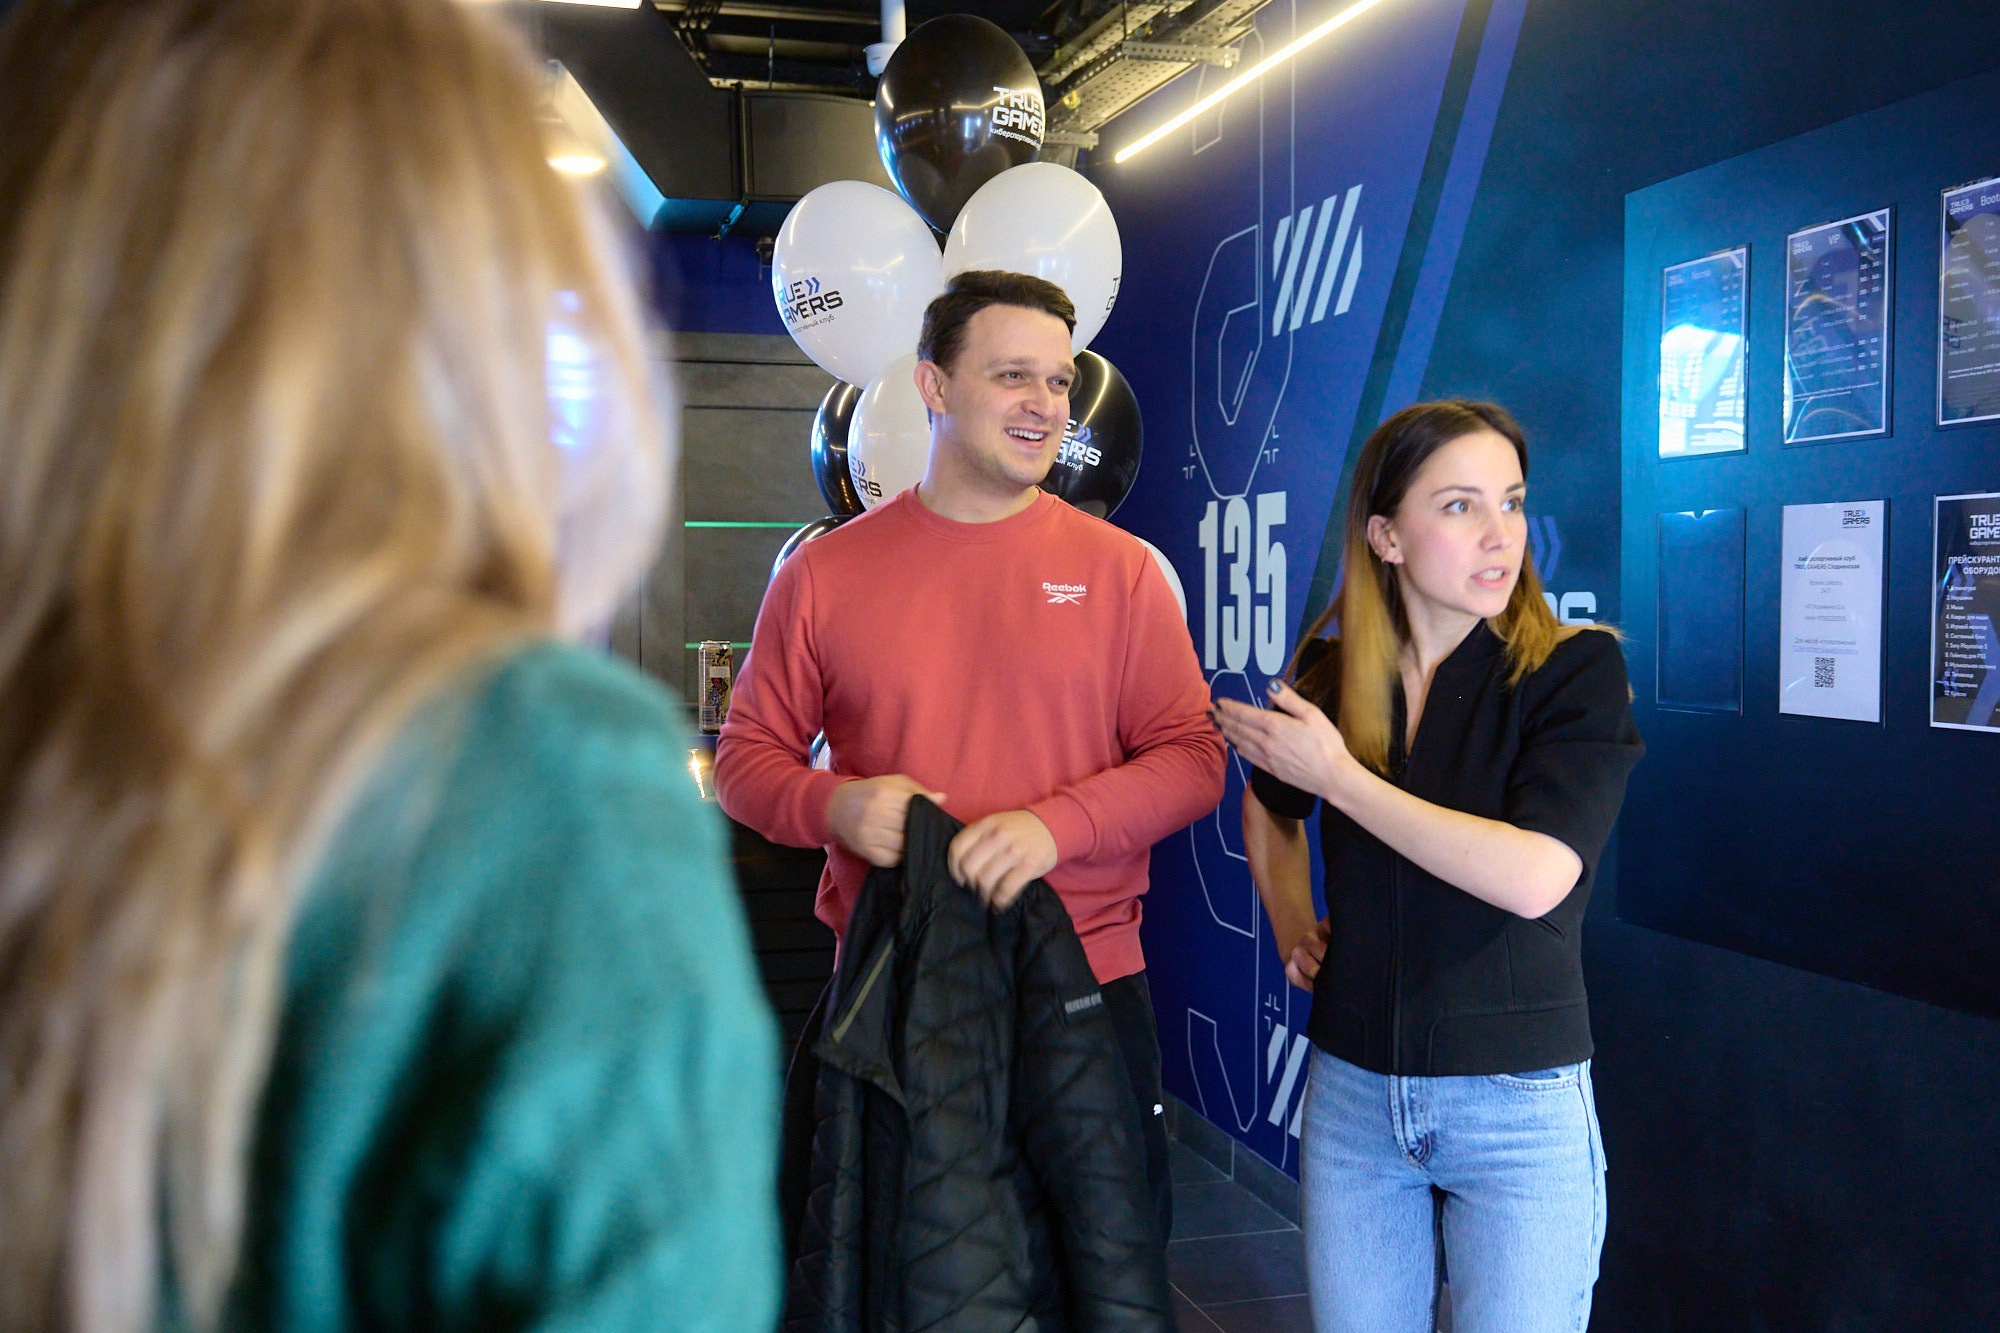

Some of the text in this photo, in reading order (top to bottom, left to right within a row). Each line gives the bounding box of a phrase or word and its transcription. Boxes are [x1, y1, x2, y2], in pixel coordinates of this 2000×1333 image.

[1066, 461, 1084, 472] клуб
[1842, 517, 1870, 525] GAMERS
[1948, 555, 2000, 565] ПРЕЙСКУРАНТ
[1042, 582, 1087, 592] Reebok
[1199, 491, 1287, 675] 135
